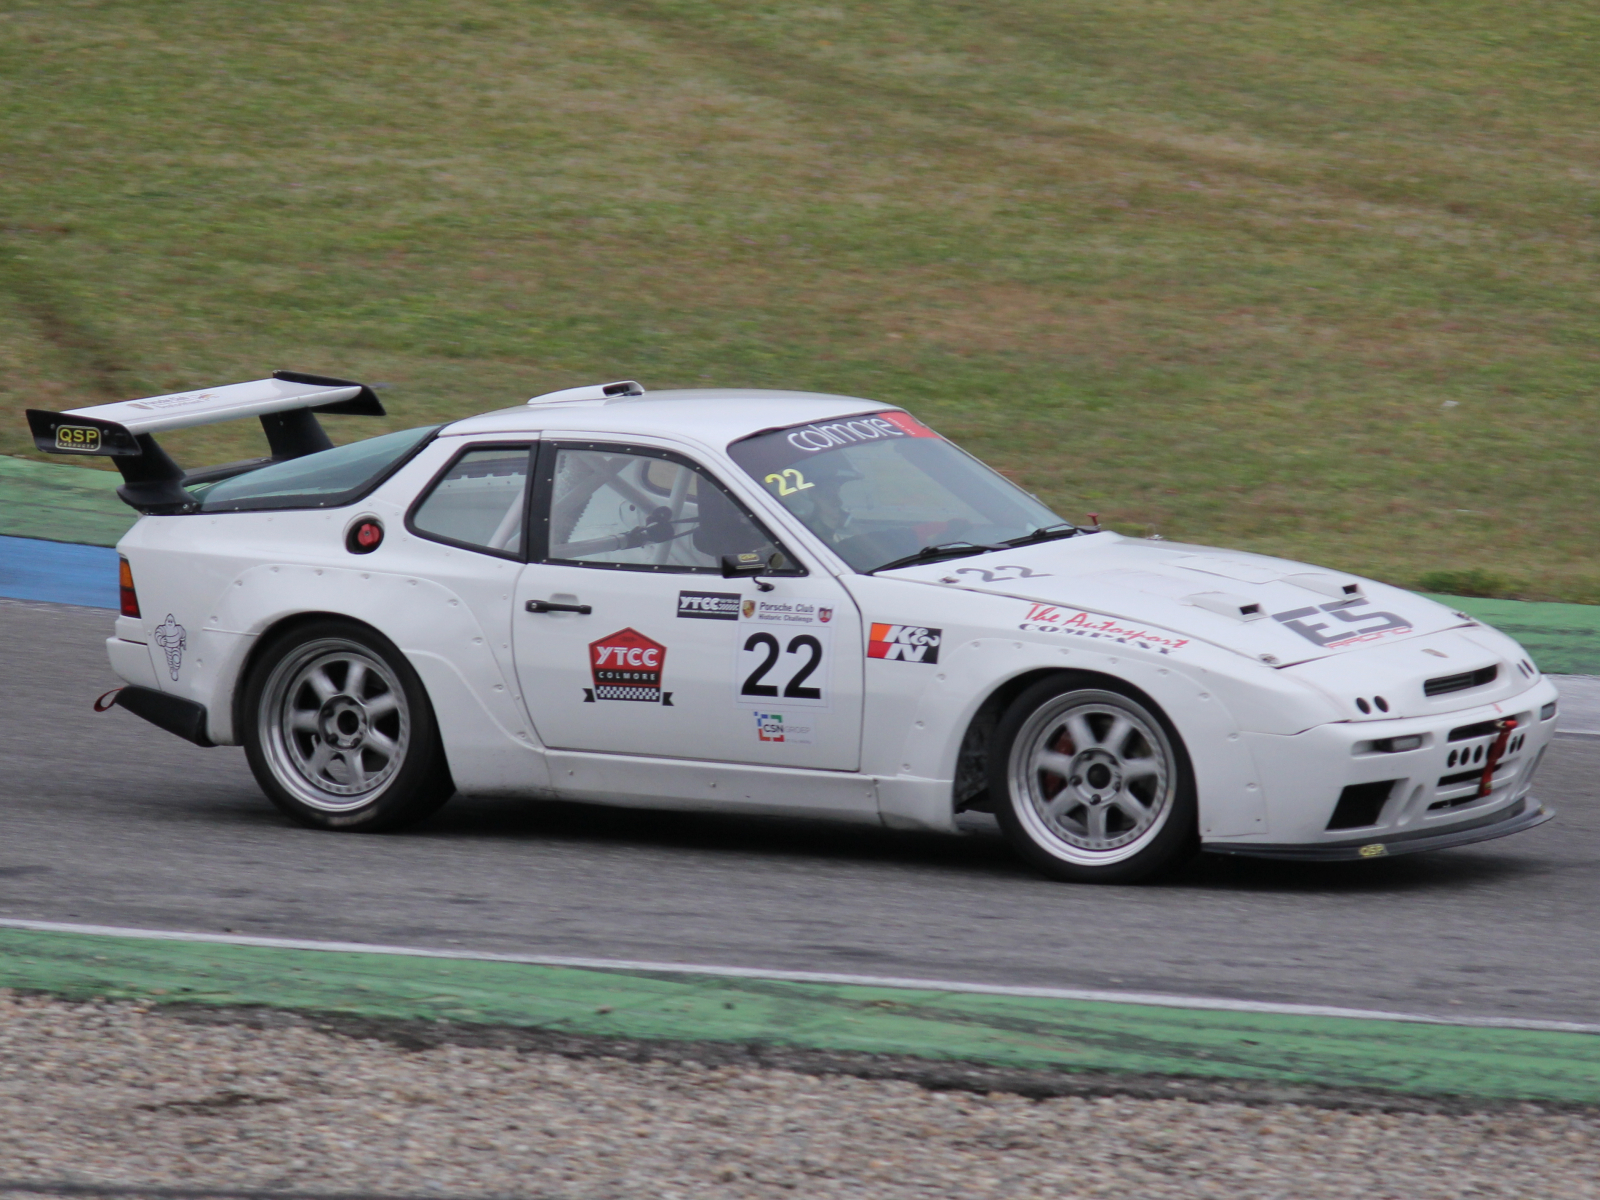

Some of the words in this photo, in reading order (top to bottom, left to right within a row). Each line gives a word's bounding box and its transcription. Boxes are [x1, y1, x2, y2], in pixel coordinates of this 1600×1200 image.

[60, 428, 97, 442] QSP
[787, 418, 904, 451] colmore
[765, 468, 815, 496] 22
[955, 565, 1054, 582] 22
[679, 596, 720, 610] YTCC
[759, 602, 792, 612] Porsche
[795, 604, 814, 613] Club
[758, 613, 782, 621] Historic
[783, 615, 813, 623] Challenge
[1025, 602, 1060, 622] The
[1061, 613, 1190, 649] Autosport
[595, 646, 659, 667] YTCC
[741, 632, 822, 699] 22
[598, 671, 656, 681] COLMORE
[763, 724, 783, 733] CSN
